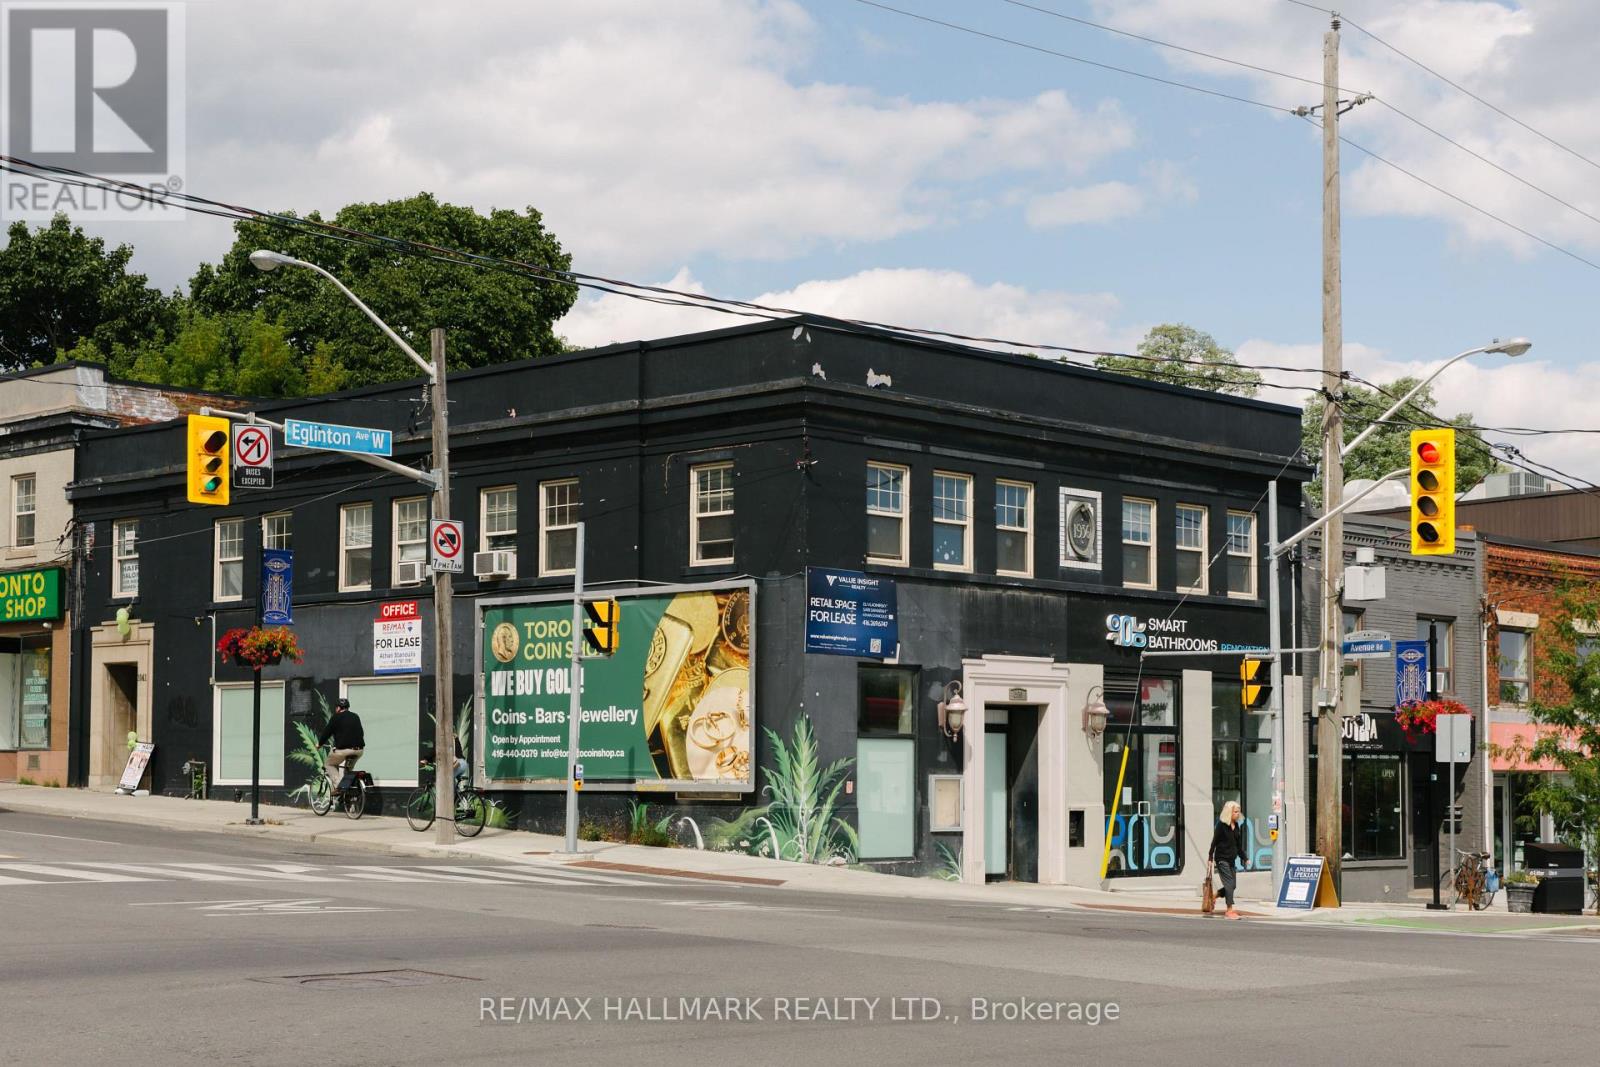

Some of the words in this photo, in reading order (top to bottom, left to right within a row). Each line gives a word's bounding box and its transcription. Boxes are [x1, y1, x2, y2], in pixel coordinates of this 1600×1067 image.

[292, 424, 350, 445] Eglinton
[355, 431, 369, 441] Ave
[372, 433, 384, 449] W
[245, 468, 261, 476] BUSES
[241, 477, 265, 486] EXCEPTED
[838, 576, 857, 584] VALUE
[857, 578, 879, 586] INSIGHT
[6, 597, 46, 618] SHOP
[383, 603, 415, 616] OFFICE
[810, 597, 834, 608] RETAIL
[835, 599, 857, 610] SPACE
[810, 610, 829, 622] FOR
[831, 612, 857, 625] LEASE
[383, 623, 406, 632] RE/MAX
[524, 619, 598, 639] TOROT
[1148, 618, 1187, 633] SMART
[375, 639, 392, 649] FOR
[394, 637, 421, 648] LEASE
[1148, 636, 1217, 652] BATHROOMS
[524, 642, 562, 660] COIN
[491, 670, 514, 696] WE
[516, 669, 543, 695] BUY
[546, 667, 585, 694] GOL!
[492, 708, 527, 724] Coins
[535, 707, 565, 724] Bars
[492, 735, 510, 746] Open
[510, 735, 519, 746] by
[519, 735, 561, 745] Appointment
[492, 749, 538, 758] 416-440-0379
[540, 748, 625, 759] info@tortocoinshop.ca
